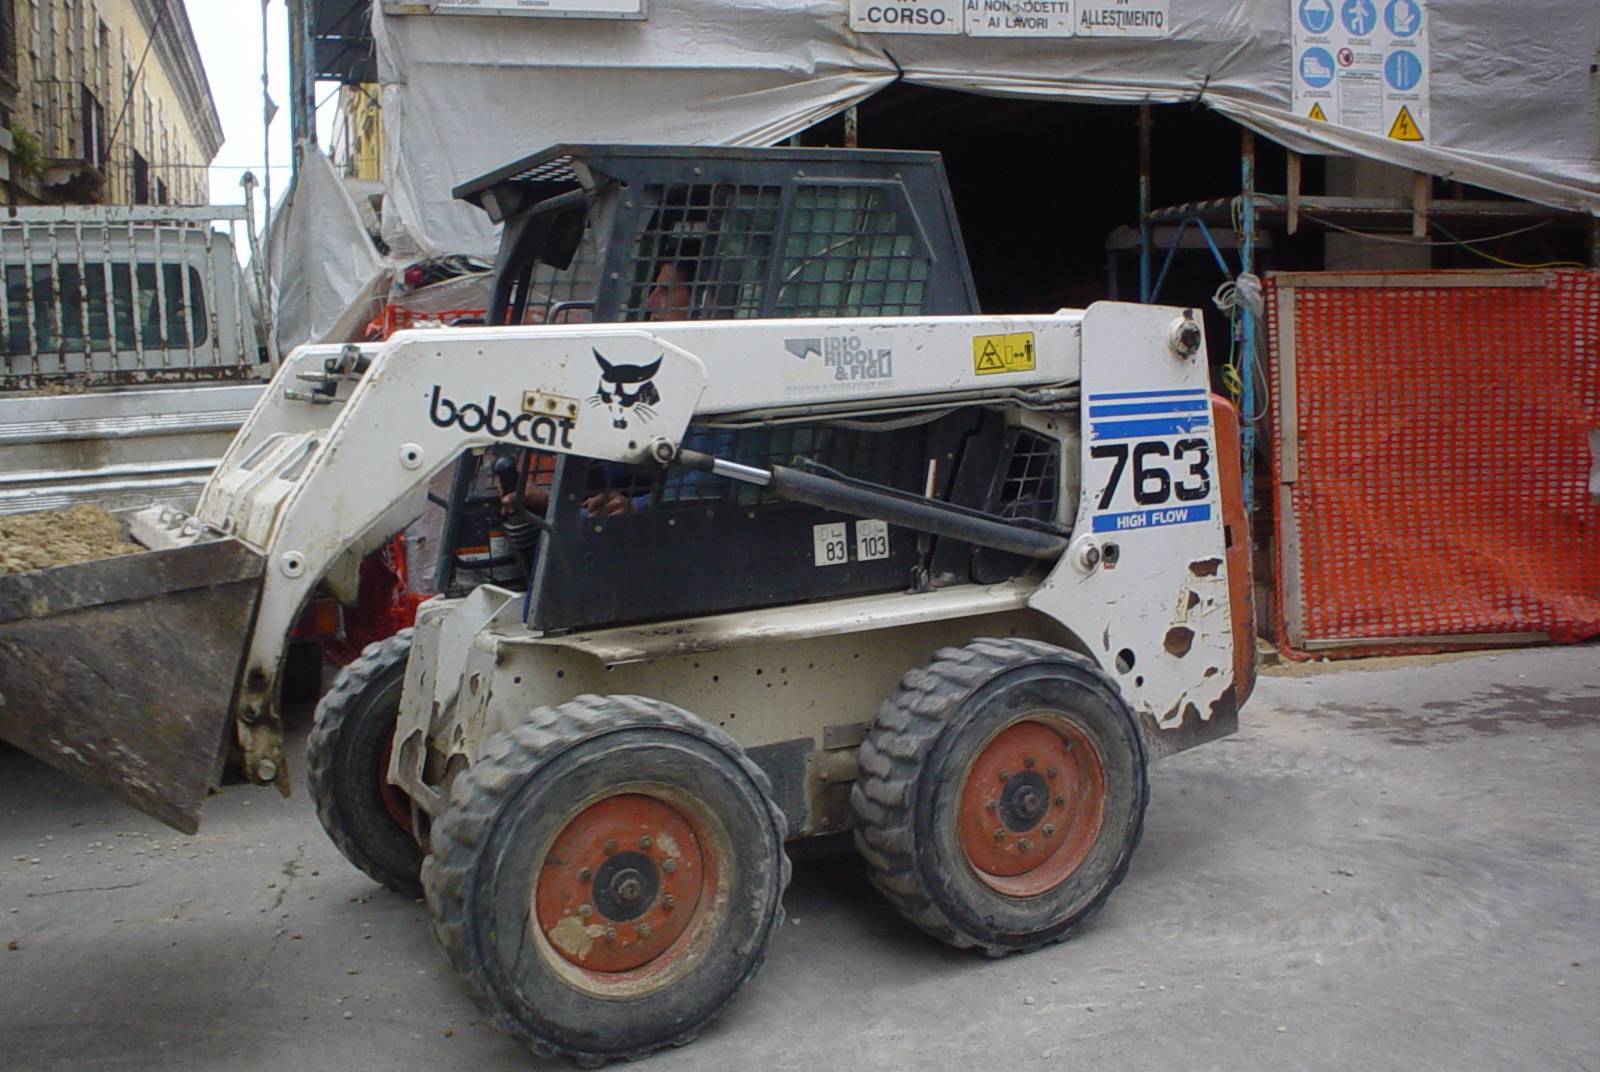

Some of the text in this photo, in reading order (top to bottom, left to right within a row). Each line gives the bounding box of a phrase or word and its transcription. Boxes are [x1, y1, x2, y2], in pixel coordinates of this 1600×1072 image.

[967, 0, 979, 11] AI
[984, 0, 1010, 12] NON
[867, 7, 945, 25] CORSO
[988, 16, 1049, 29] AI LAVORI
[1081, 9, 1164, 27] ALLESTIMENTO
[835, 366, 848, 380] &
[429, 385, 576, 449] bobcat
[1090, 438, 1211, 511] 763
[1116, 509, 1189, 529] HIGH FLOW
[826, 540, 845, 562] 83
[861, 536, 887, 558] 103
